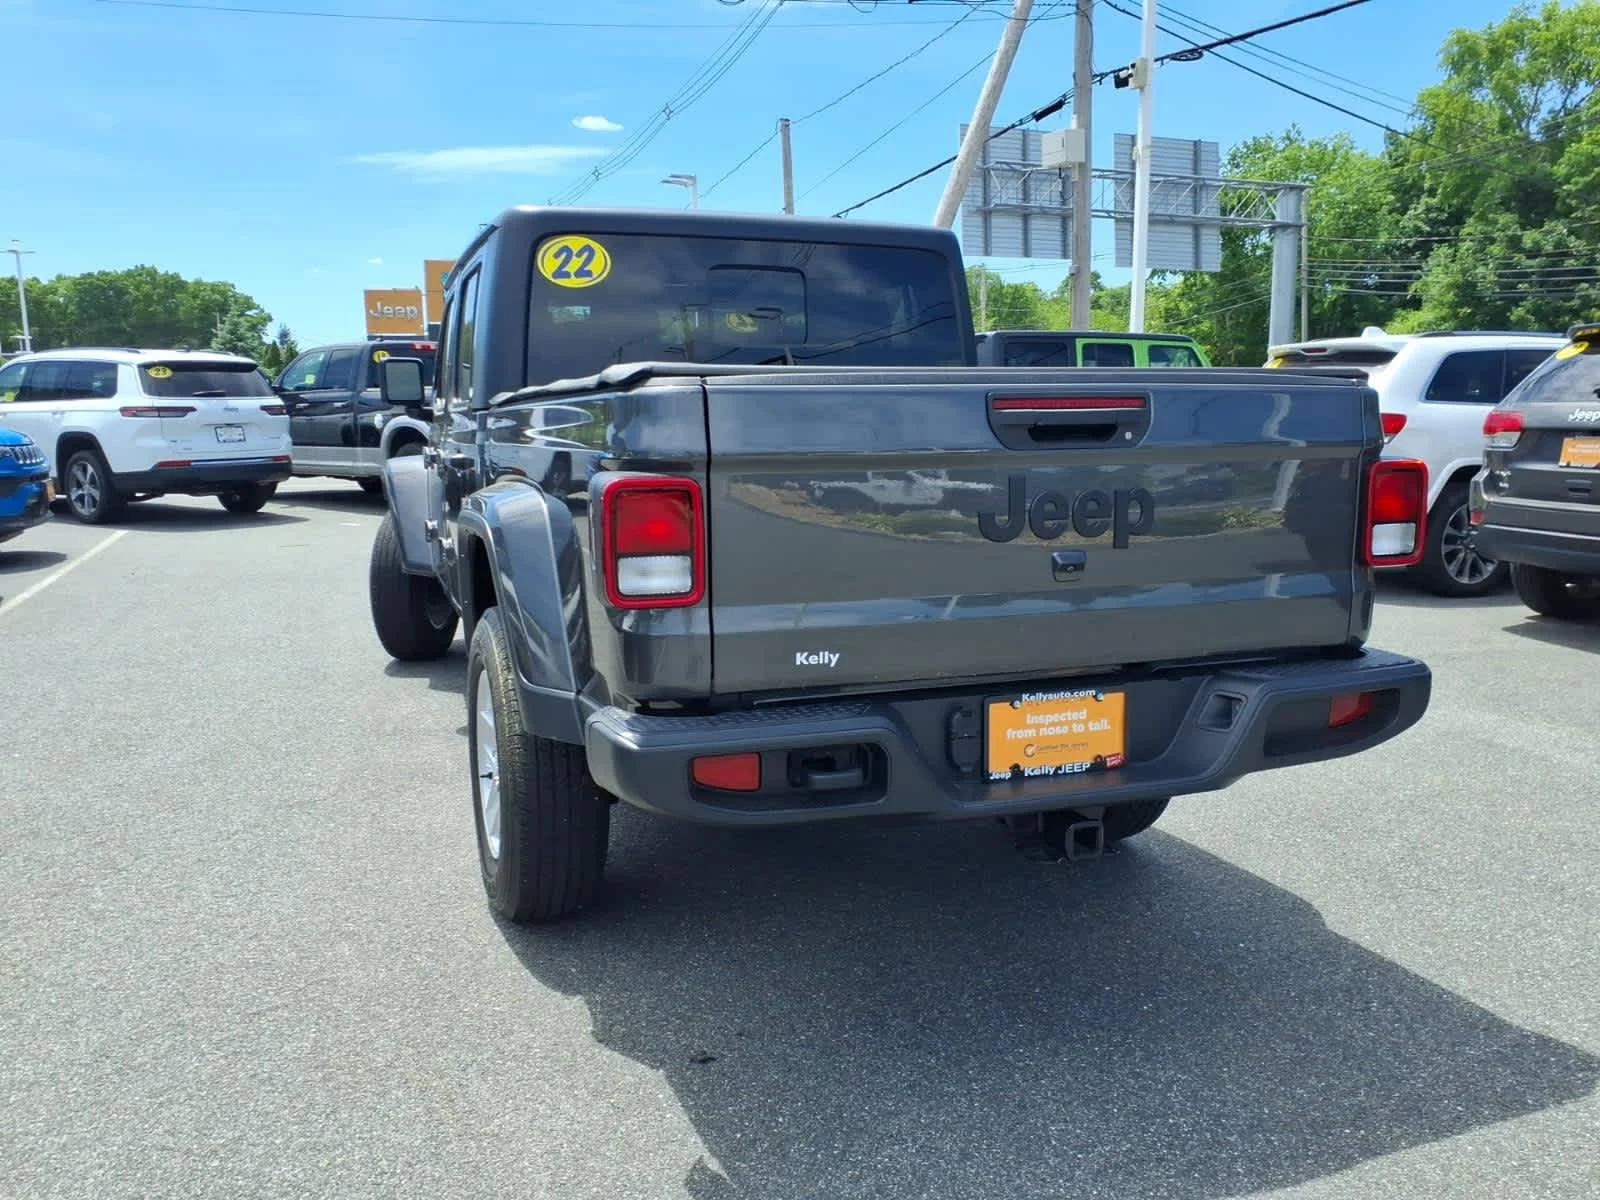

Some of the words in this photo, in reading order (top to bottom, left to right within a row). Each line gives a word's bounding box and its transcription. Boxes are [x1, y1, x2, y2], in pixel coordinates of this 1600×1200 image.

[551, 243, 596, 279] 22
[369, 301, 418, 320] Jeep
[1568, 408, 1600, 424] Jeep
[977, 475, 1155, 549] Jeep
[795, 651, 840, 668] Kelly
[1021, 689, 1096, 703] Kellyauto.com
[1026, 709, 1088, 725] Inspected
[1006, 728, 1036, 739] from
[1039, 725, 1069, 737] nose
[1072, 722, 1086, 733] to
[1088, 719, 1112, 732] tail.
[989, 771, 1012, 781] Jeep
[1024, 764, 1057, 777] Kelly
[1057, 762, 1091, 774] JEEP
